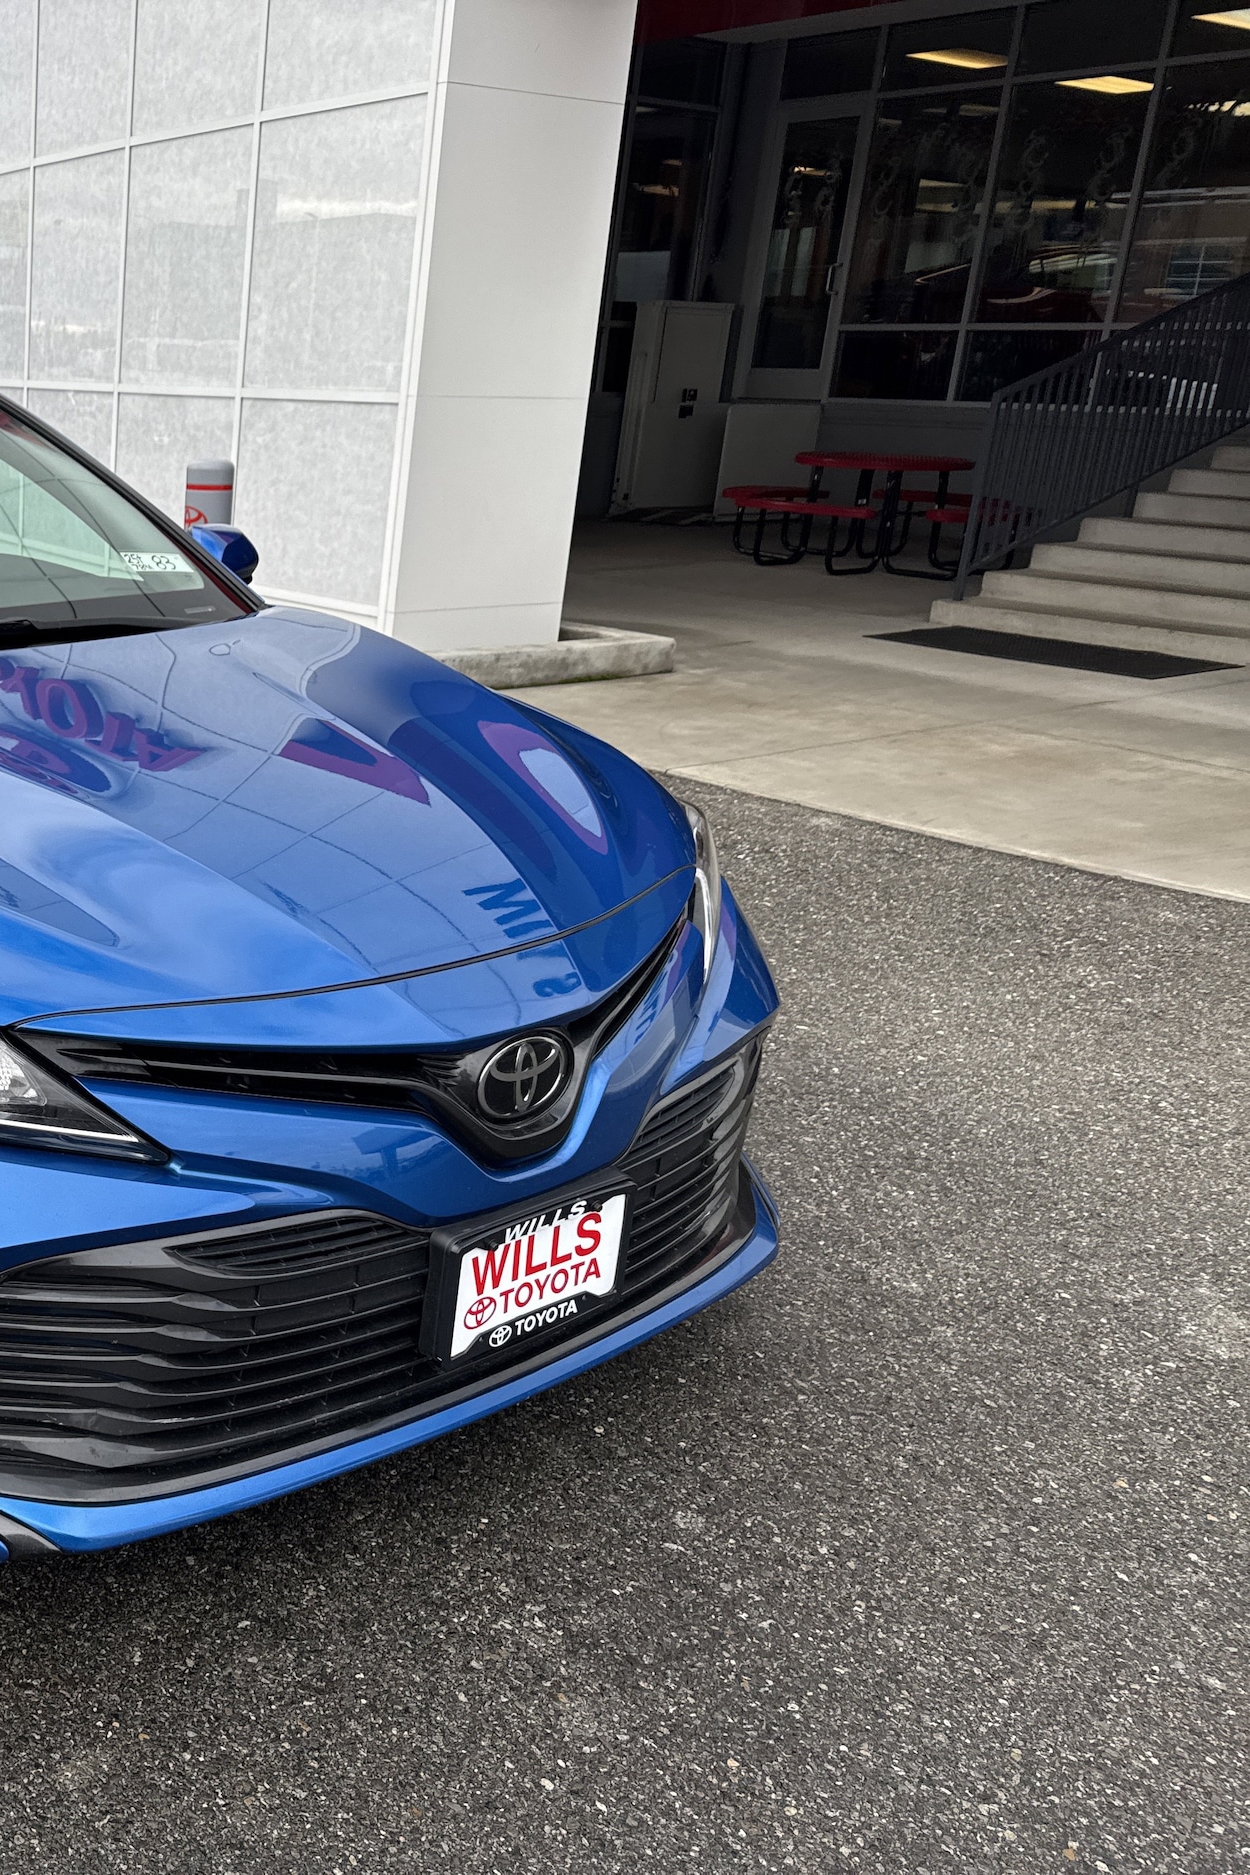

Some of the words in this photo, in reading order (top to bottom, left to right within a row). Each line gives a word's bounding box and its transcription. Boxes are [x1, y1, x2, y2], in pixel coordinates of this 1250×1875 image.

[151, 554, 177, 571] 83
[504, 1200, 588, 1243] WILLS
[471, 1212, 602, 1297] WILLS
[499, 1257, 602, 1314] TOYOTA
[514, 1299, 579, 1336] TOYOTA
